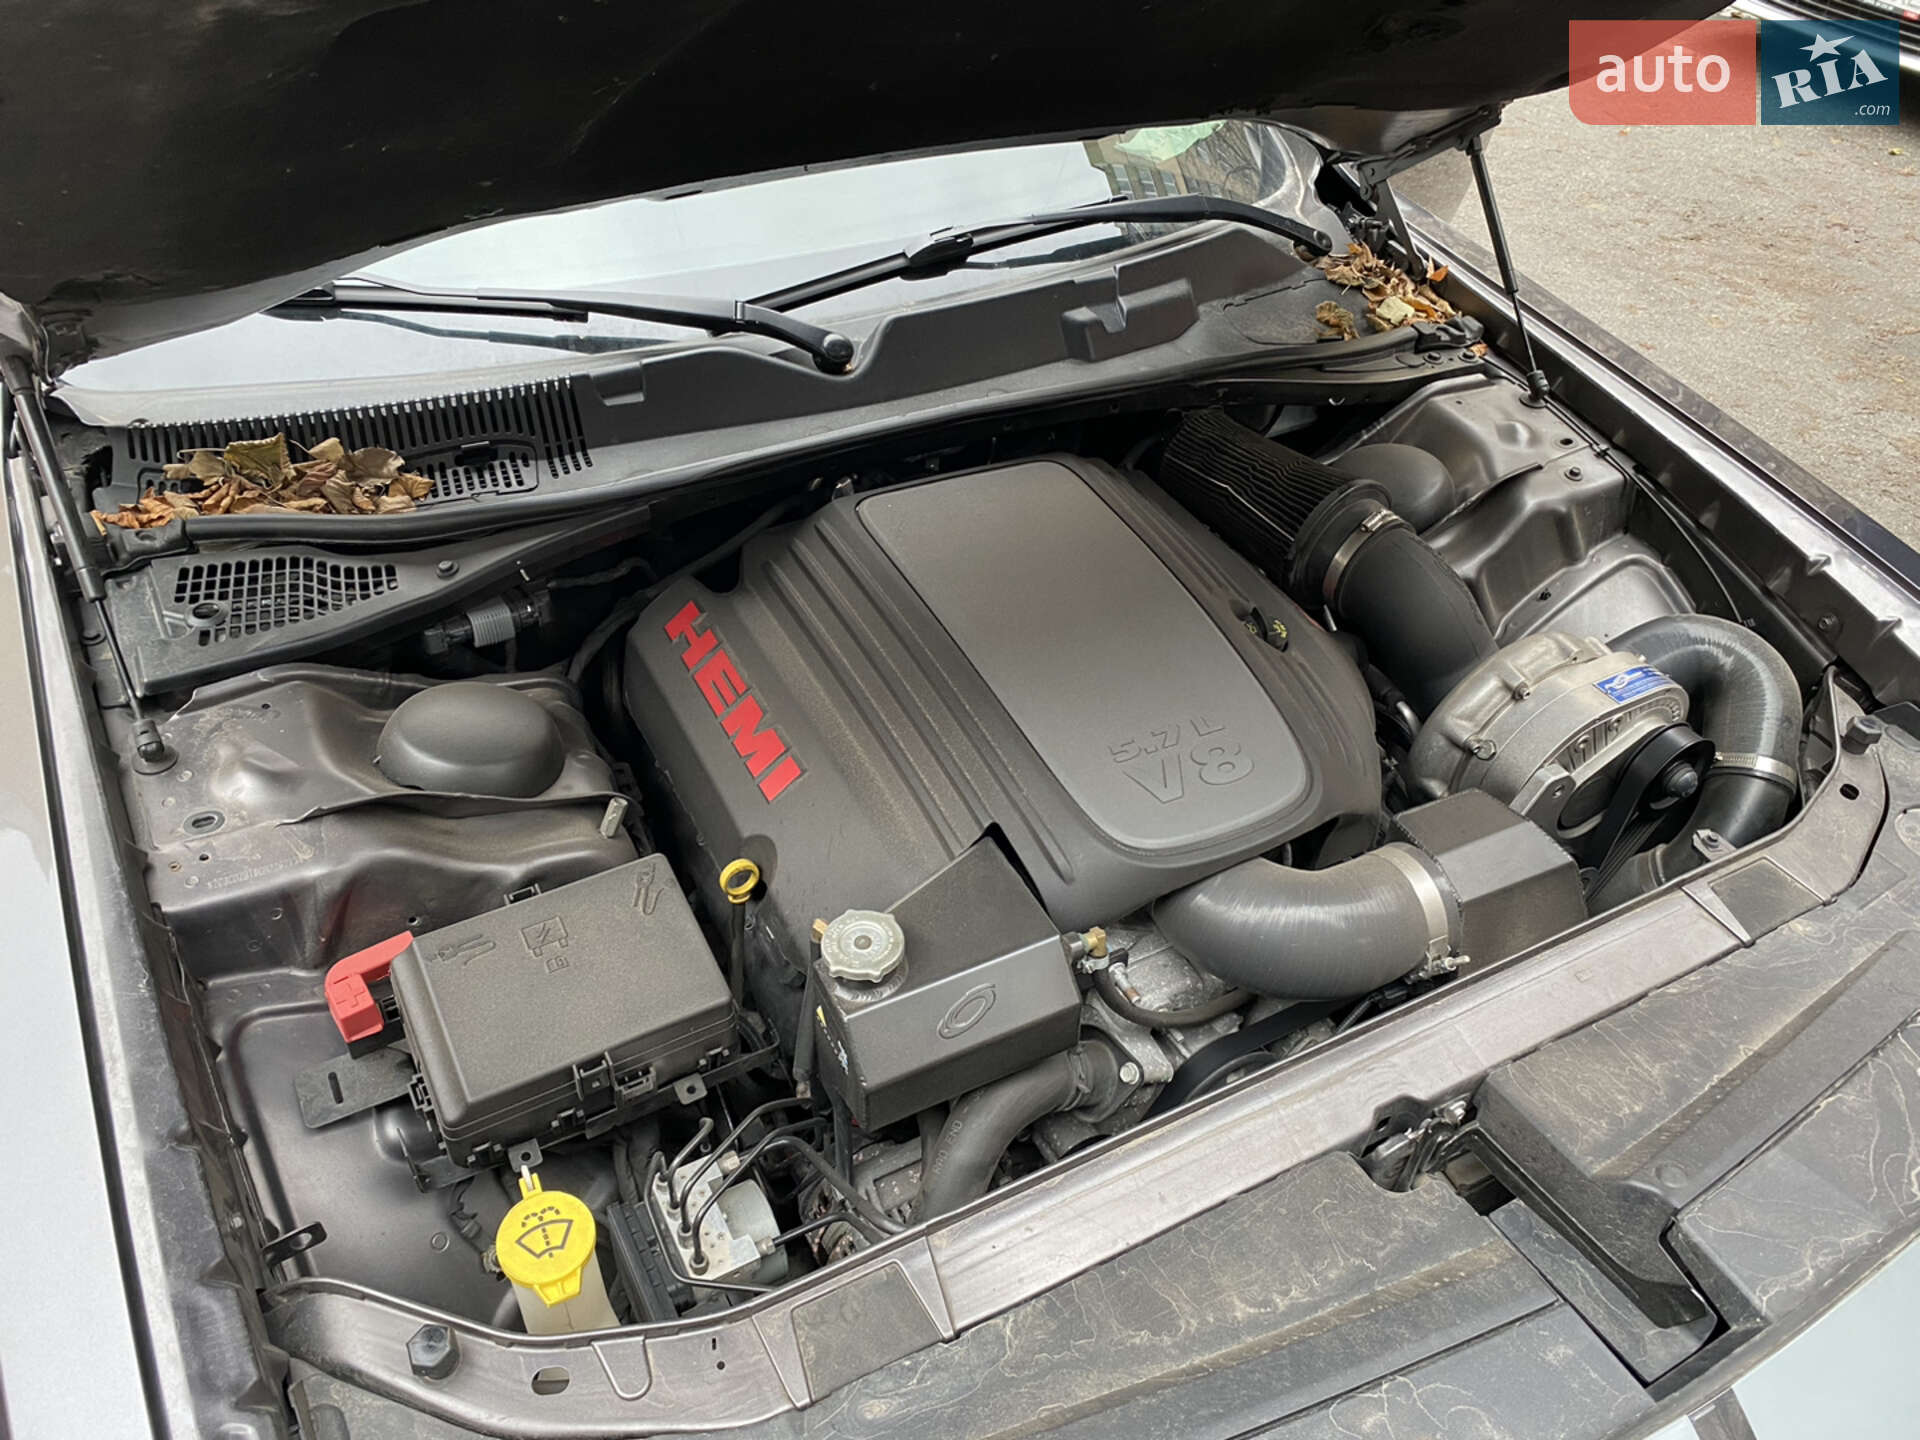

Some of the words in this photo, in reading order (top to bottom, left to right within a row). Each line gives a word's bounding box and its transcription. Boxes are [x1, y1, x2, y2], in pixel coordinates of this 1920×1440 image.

[664, 600, 803, 804] HEMI
[1107, 715, 1226, 764] 5.7L
[1121, 742, 1256, 805] V8
[944, 1119, 963, 1145] END
